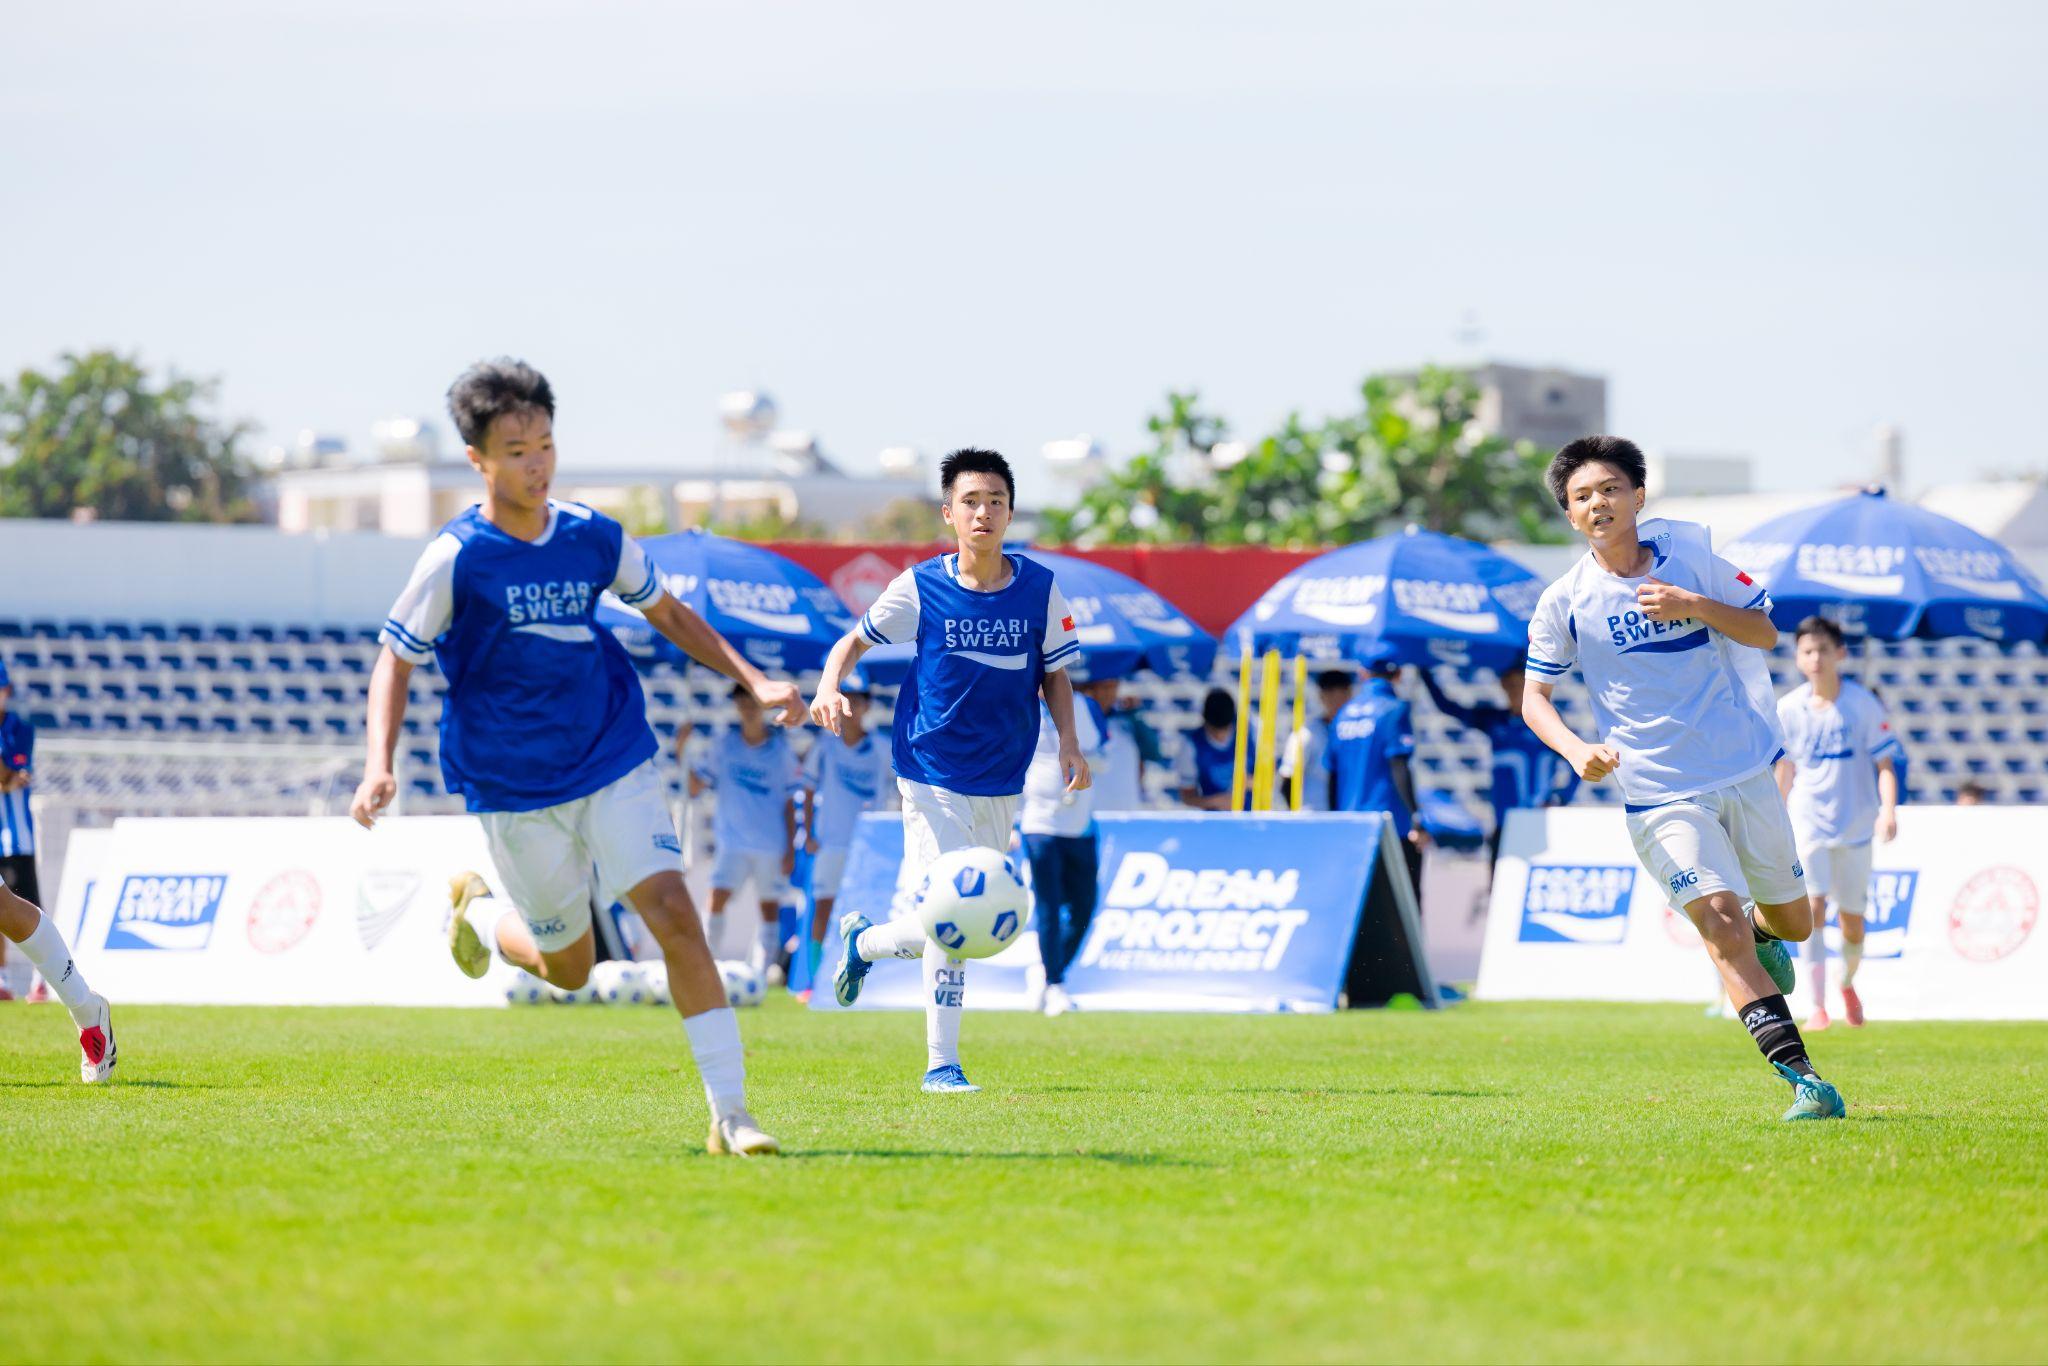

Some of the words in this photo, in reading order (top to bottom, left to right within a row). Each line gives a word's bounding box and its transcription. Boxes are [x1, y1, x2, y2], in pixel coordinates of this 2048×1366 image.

[506, 581, 597, 604] POCAR
[945, 619, 1028, 633] POCARI
[945, 633, 1022, 648] SWEAT
[124, 877, 222, 901] POCARI
[1106, 852, 1299, 908] DREAM
[1670, 871, 1698, 894] BMG
[1080, 909, 1309, 971] PROJECT
